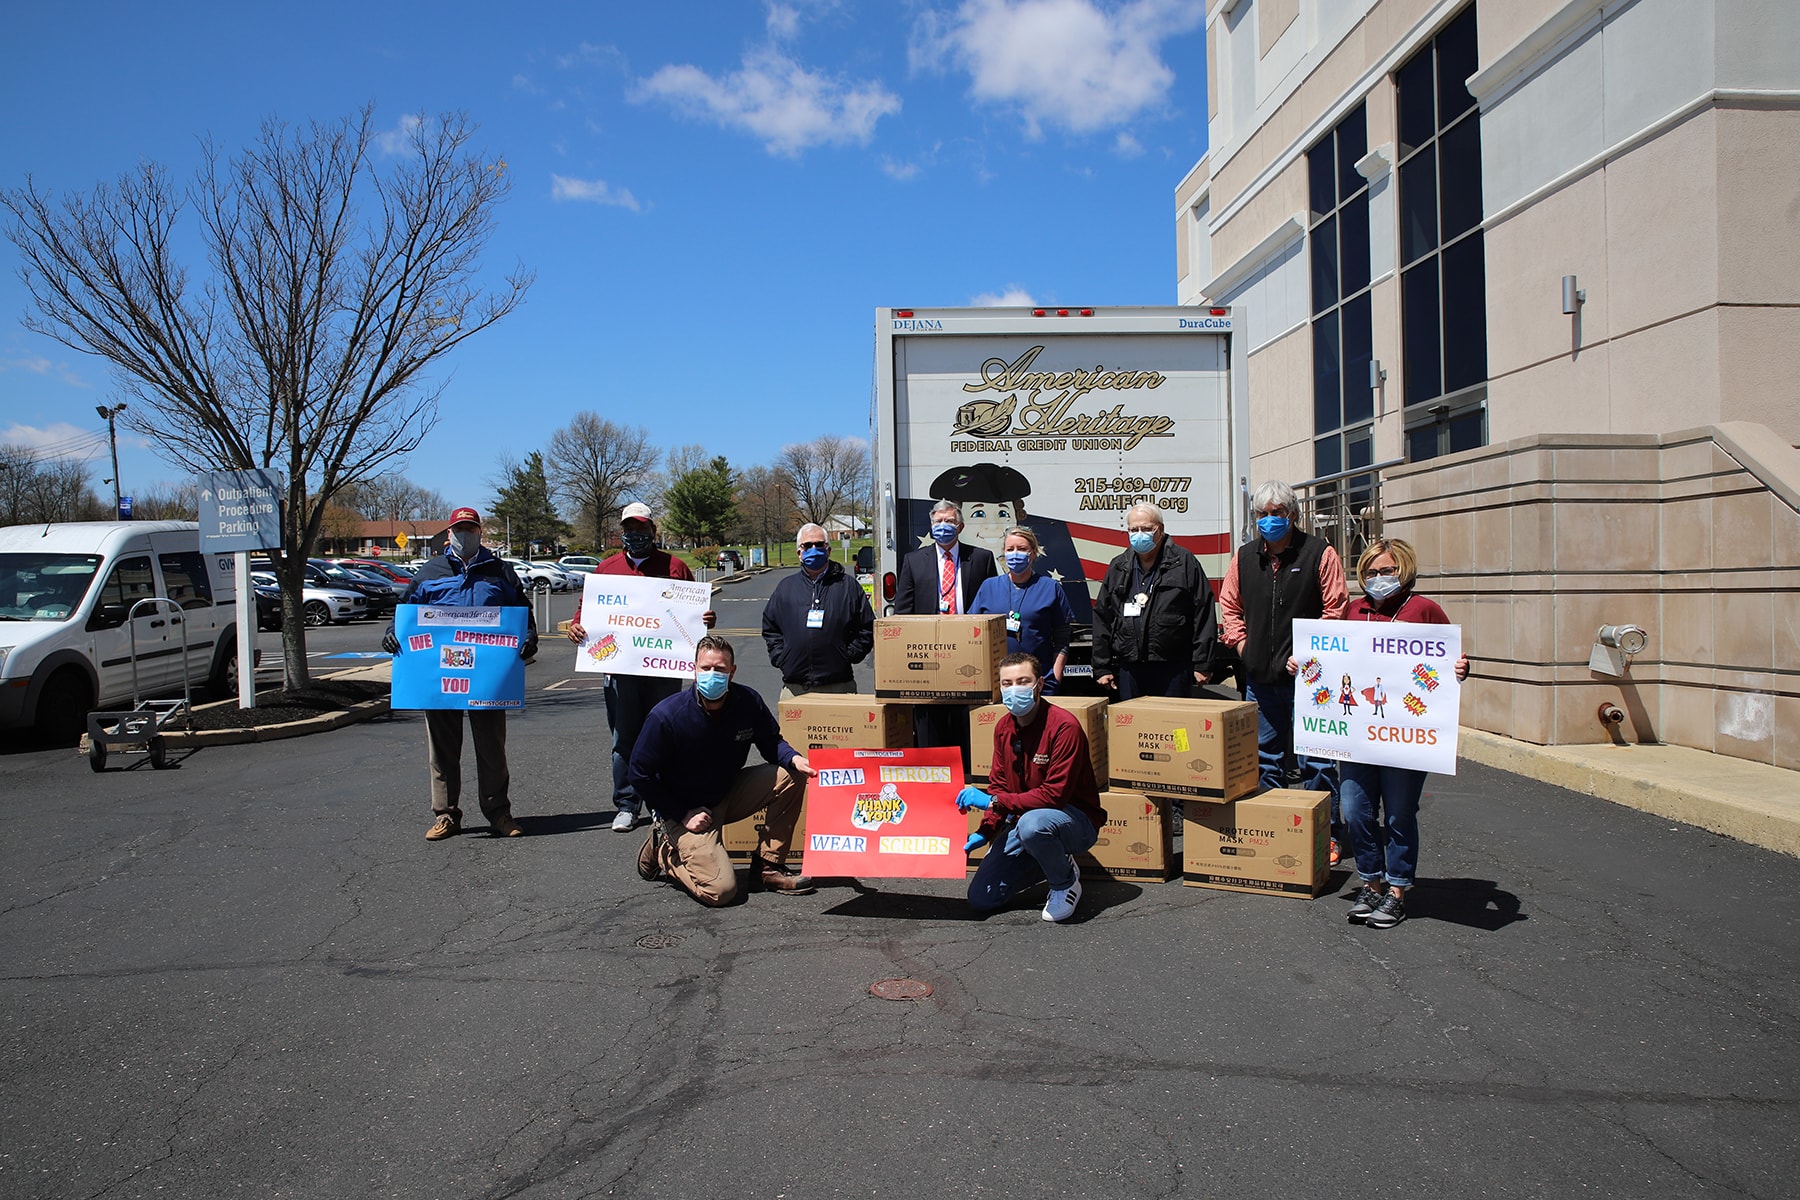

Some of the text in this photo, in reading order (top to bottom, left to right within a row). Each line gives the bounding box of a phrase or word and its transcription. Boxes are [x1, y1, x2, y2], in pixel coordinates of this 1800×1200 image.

[893, 319, 943, 331] DEJANA
[1179, 318, 1231, 328] DuraCube
[963, 345, 1167, 392] American
[1011, 388, 1175, 451] Heritage
[950, 438, 1122, 452] FEDERAL CREDIT UNION
[1074, 477, 1192, 493] 215-969-0777
[218, 485, 273, 502] Outpatient
[218, 503, 273, 517] Procedure
[219, 520, 259, 536] Parking
[671, 583, 706, 595] American
[597, 594, 629, 606] REAL
[608, 614, 661, 630] HEROES
[409, 630, 518, 651] WE APPRECIATE
[632, 636, 673, 650] WEAR
[906, 643, 957, 651] PROTECTIVE
[1311, 635, 1446, 657] REAL HEROES
[594, 643, 616, 660] YOU
[642, 656, 696, 672] SCRUBS
[1412, 663, 1440, 691] SUPER!
[442, 678, 469, 693] YOU
[807, 725, 854, 733] PROTECTIVE
[1302, 716, 1438, 745] WEAR SCRUBS
[807, 733, 828, 741] MASK
[1138, 732, 1174, 742] PROTECT
[1138, 741, 1160, 750] MASK
[819, 766, 951, 786] REAL HEROES
[857, 799, 903, 811] THANK
[867, 811, 893, 822] YOU
[1219, 826, 1276, 838] PROTECTIVE
[811, 835, 949, 853] WEAR SCRUBS
[1219, 836, 1269, 846] MASK PM2.5
